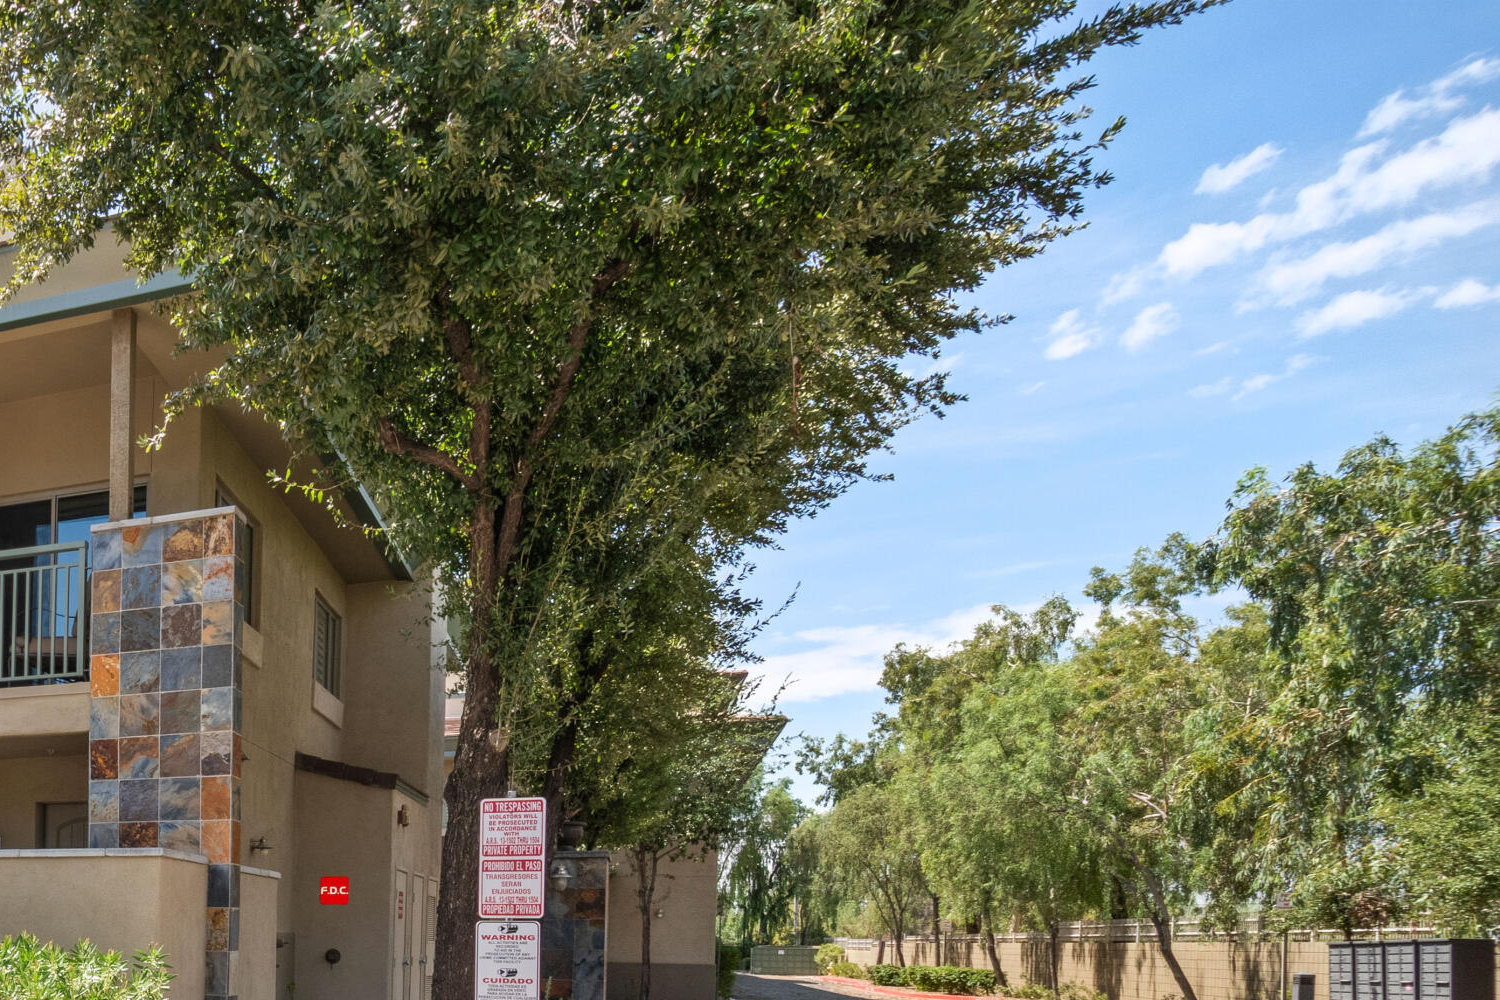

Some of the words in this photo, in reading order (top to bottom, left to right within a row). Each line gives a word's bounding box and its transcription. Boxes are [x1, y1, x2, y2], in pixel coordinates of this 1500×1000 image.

[484, 802, 494, 812] NO
[496, 801, 542, 812] TRESPASSING
[483, 845, 508, 856] PRIVATE
[509, 845, 541, 855] PROPERTY
[484, 861, 515, 871] PROHIBIDO
[516, 861, 523, 871] EL
[525, 861, 541, 871] PASO
[320, 886, 349, 895] F.D.C.
[483, 904, 514, 914] PROPIEDAD
[515, 904, 540, 914] PRIVADA
[482, 977, 534, 985] CUIDADO
